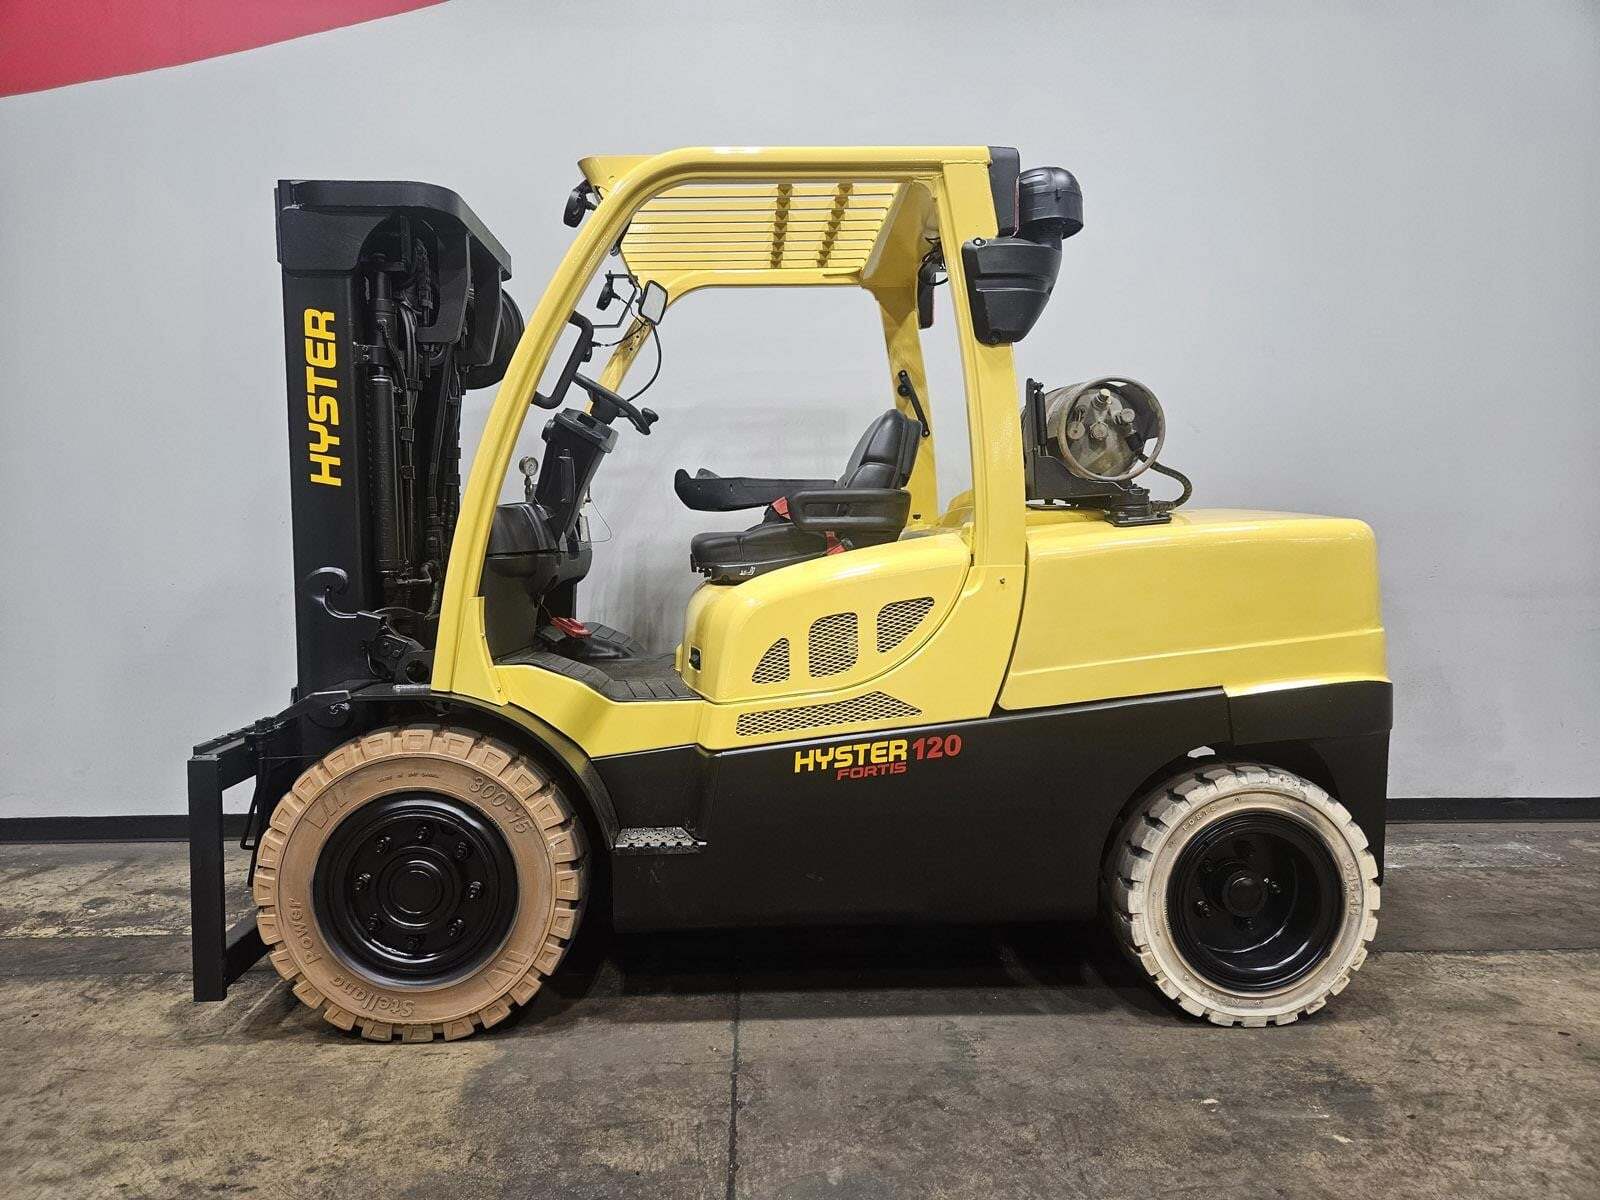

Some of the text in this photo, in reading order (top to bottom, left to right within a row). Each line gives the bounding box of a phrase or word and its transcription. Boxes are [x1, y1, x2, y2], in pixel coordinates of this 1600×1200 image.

[304, 308, 342, 487] HYSTER
[793, 734, 962, 774] HYSTER 120
[836, 761, 908, 781] FORTIS
[469, 775, 535, 834] 300-15
[287, 897, 323, 965] Power
